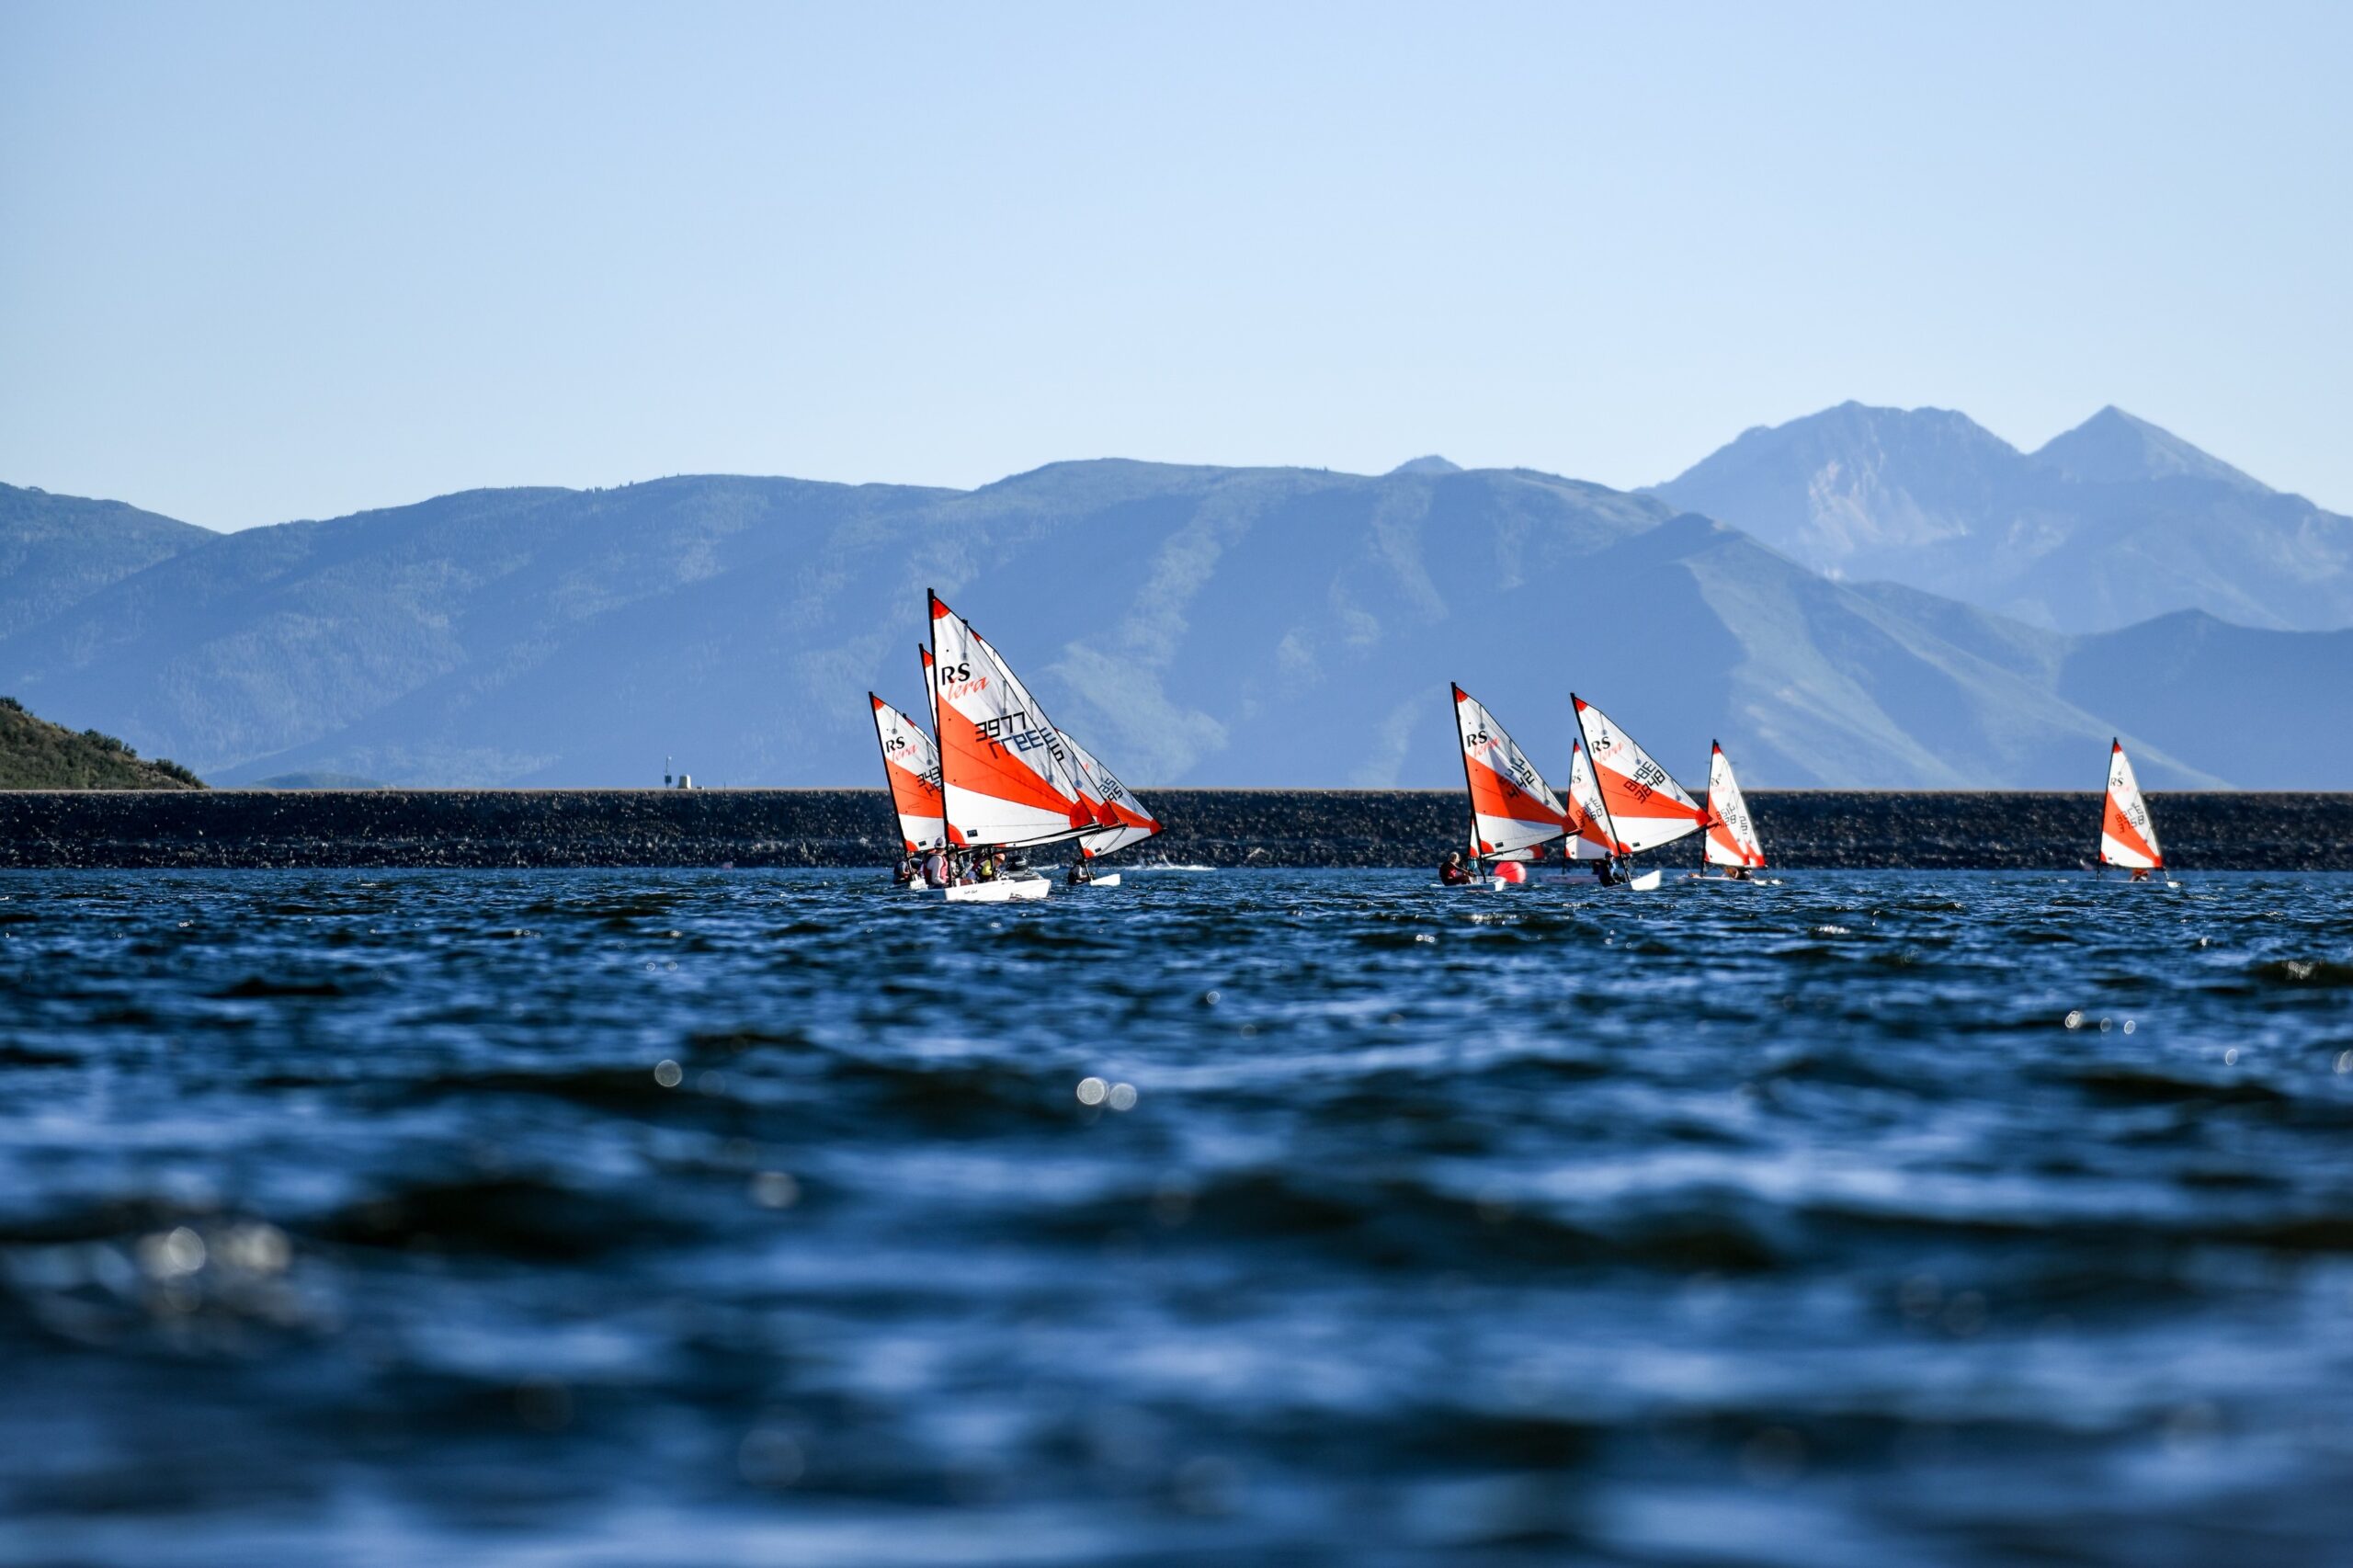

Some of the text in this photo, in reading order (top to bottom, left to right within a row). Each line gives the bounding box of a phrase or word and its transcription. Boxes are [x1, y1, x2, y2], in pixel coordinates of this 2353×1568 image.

[941, 663, 971, 686] RS
[975, 711, 1027, 743] 3977
[885, 736, 905, 753] RS
[1467, 731, 1487, 747] RS
[1591, 736, 1610, 754] RS
[916, 766, 941, 788] 343
[1634, 769, 1665, 804] 3848
[2110, 778, 2123, 787] RS
